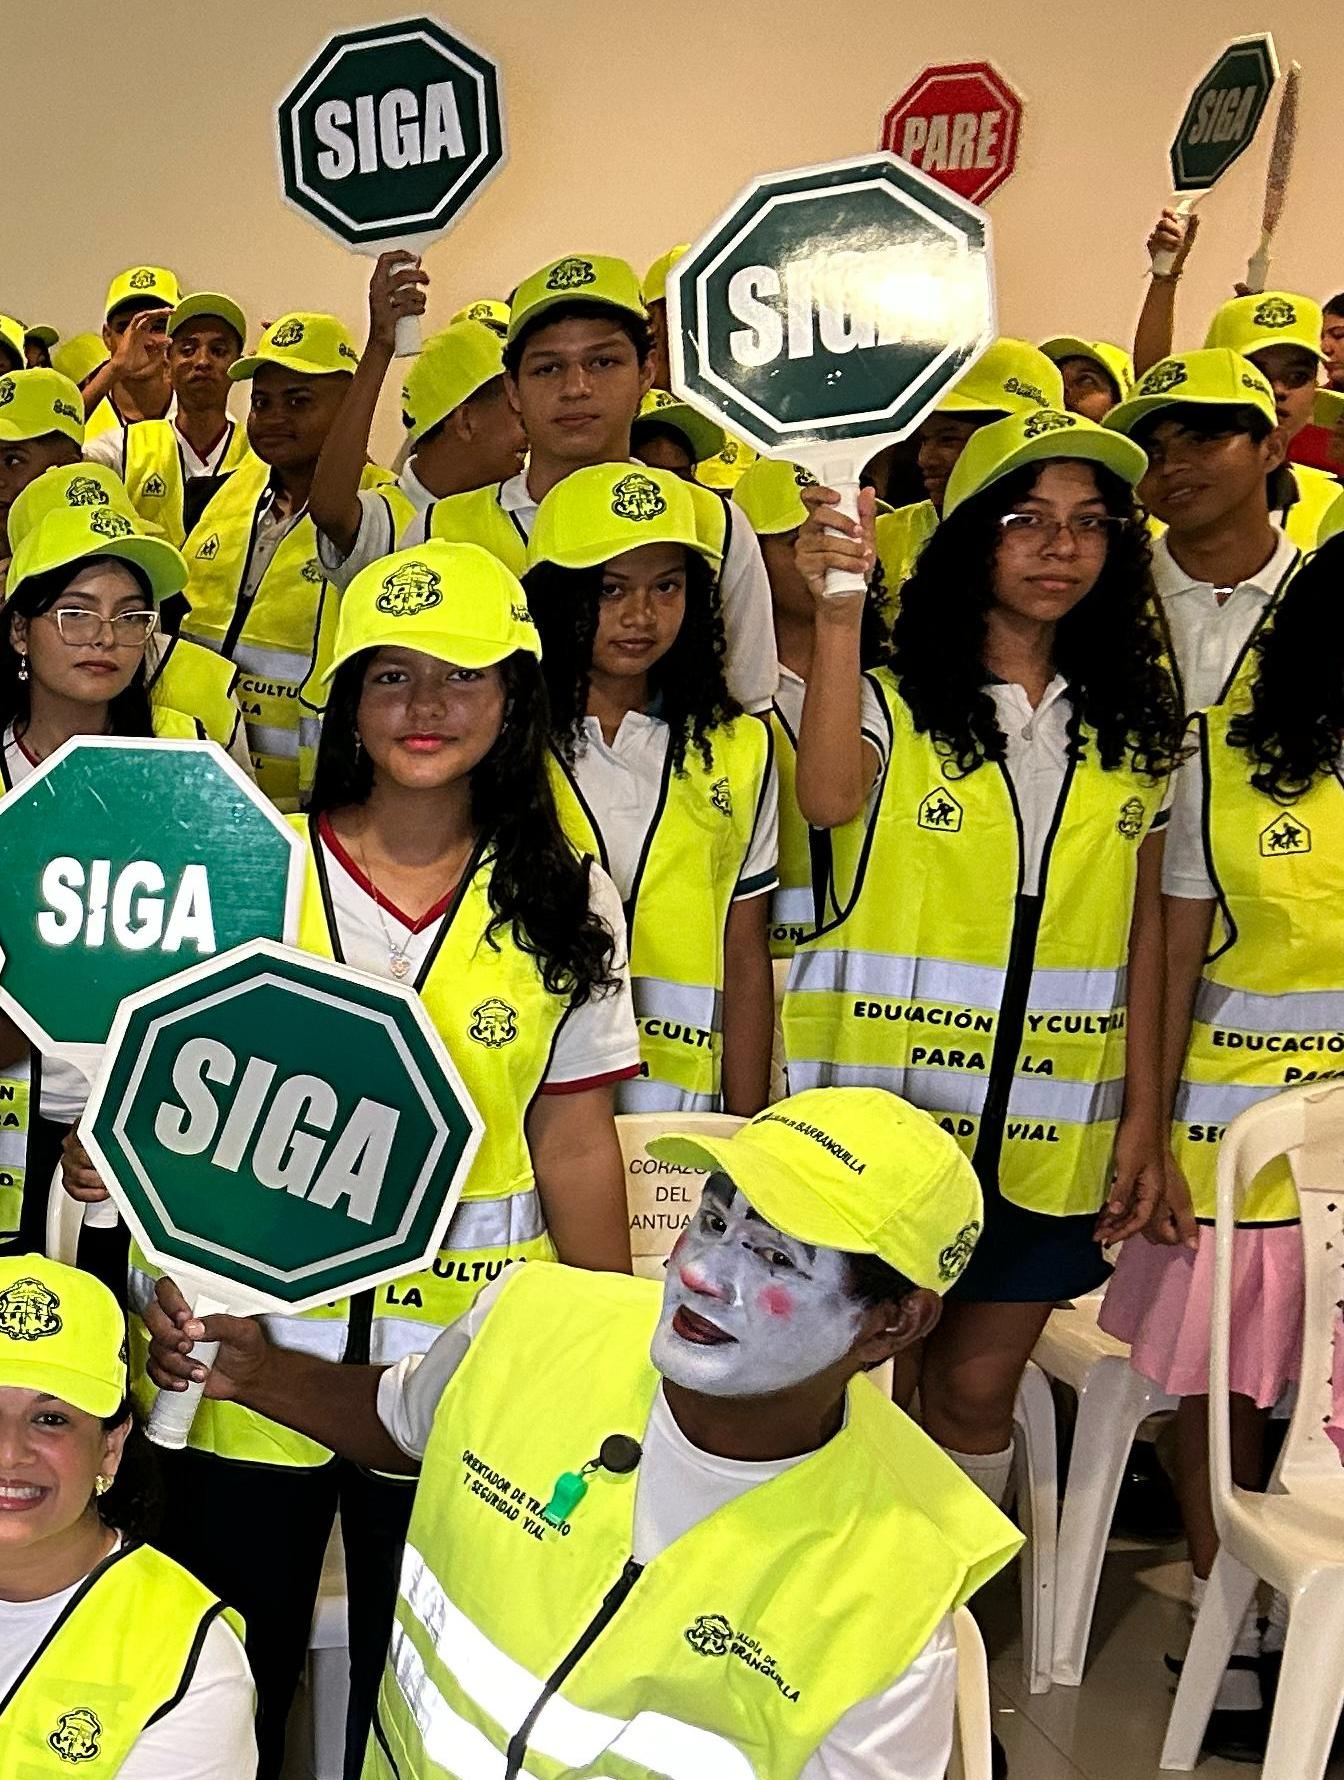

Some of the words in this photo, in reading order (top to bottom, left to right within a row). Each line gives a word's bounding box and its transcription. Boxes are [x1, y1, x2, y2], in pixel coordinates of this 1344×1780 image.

[315, 80, 467, 180] SIGA
[1187, 85, 1258, 146] SIGA
[902, 109, 1002, 173] PARE
[242, 679, 300, 699] CULTU
[241, 701, 262, 716] LA
[37, 856, 216, 953] SIGA
[645, 1019, 712, 1050] CULT
[1212, 1031, 1344, 1052] EDUCACIÓ
[912, 1047, 986, 1070] PARA
[1021, 1056, 1054, 1076] LA
[153, 1037, 402, 1226] SIGA
[1007, 1123, 1060, 1142] VIAL
[794, 1121, 867, 1176] BARRANQUILLA
[629, 1159, 708, 1175] CORAZ
[655, 1186, 692, 1202] DEL
[630, 1214, 691, 1230] ANTUA
[386, 1284, 424, 1309] LA
[462, 1449, 512, 1495] ORIENTADOR
[510, 1487, 526, 1505] DE
[463, 1472, 471, 1485] Y
[471, 1480, 520, 1521] SEGURIDAD
[522, 1516, 546, 1541] VIAL
